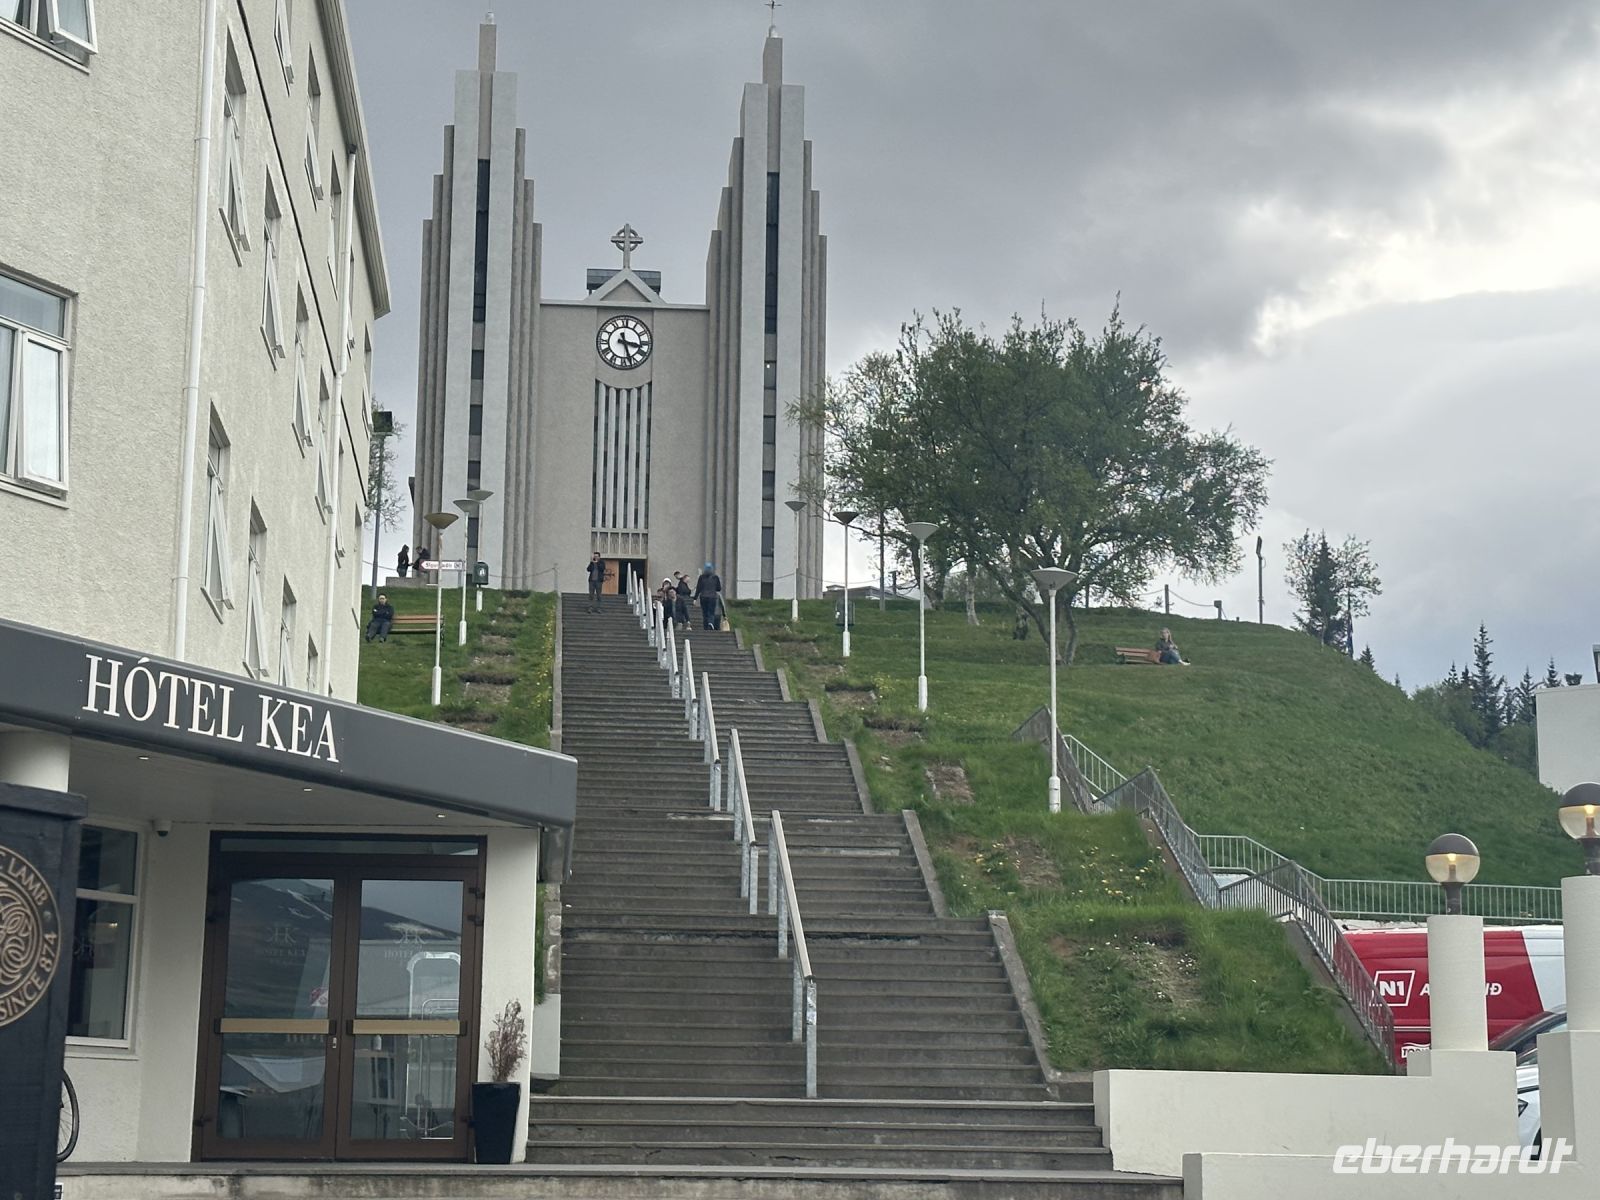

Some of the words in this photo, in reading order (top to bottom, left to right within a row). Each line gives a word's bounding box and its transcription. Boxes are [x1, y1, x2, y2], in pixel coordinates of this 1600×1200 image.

[82, 654, 244, 743] HÓTEL
[256, 694, 339, 763] KEA
[8, 857, 48, 905] LAMB
[0, 971, 45, 1020] SINCE
[40, 932, 57, 972] 874
[1380, 981, 1405, 996] N1
